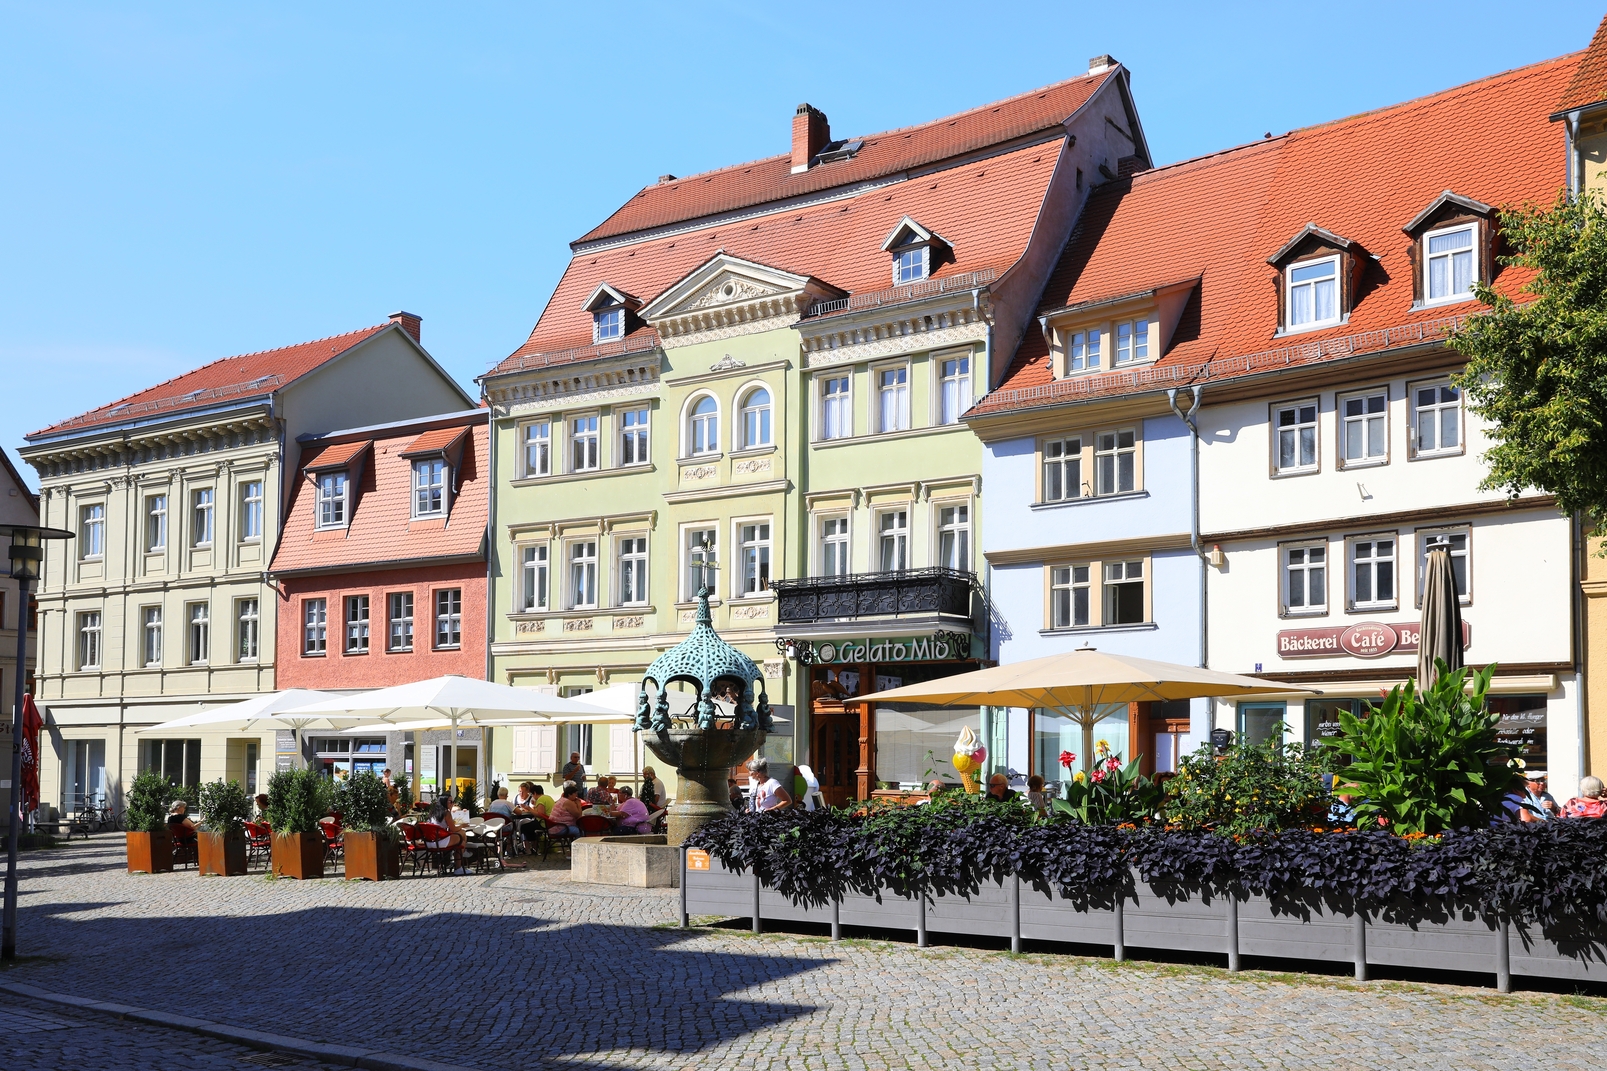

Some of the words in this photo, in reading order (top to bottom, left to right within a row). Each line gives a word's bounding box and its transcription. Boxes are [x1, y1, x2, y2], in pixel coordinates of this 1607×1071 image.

[1280, 634, 1338, 651] Bäckerei
[1350, 630, 1385, 648] Café
[840, 638, 906, 663] Gelato
[910, 634, 950, 661] Mio
[1522, 727, 1535, 735] oder
